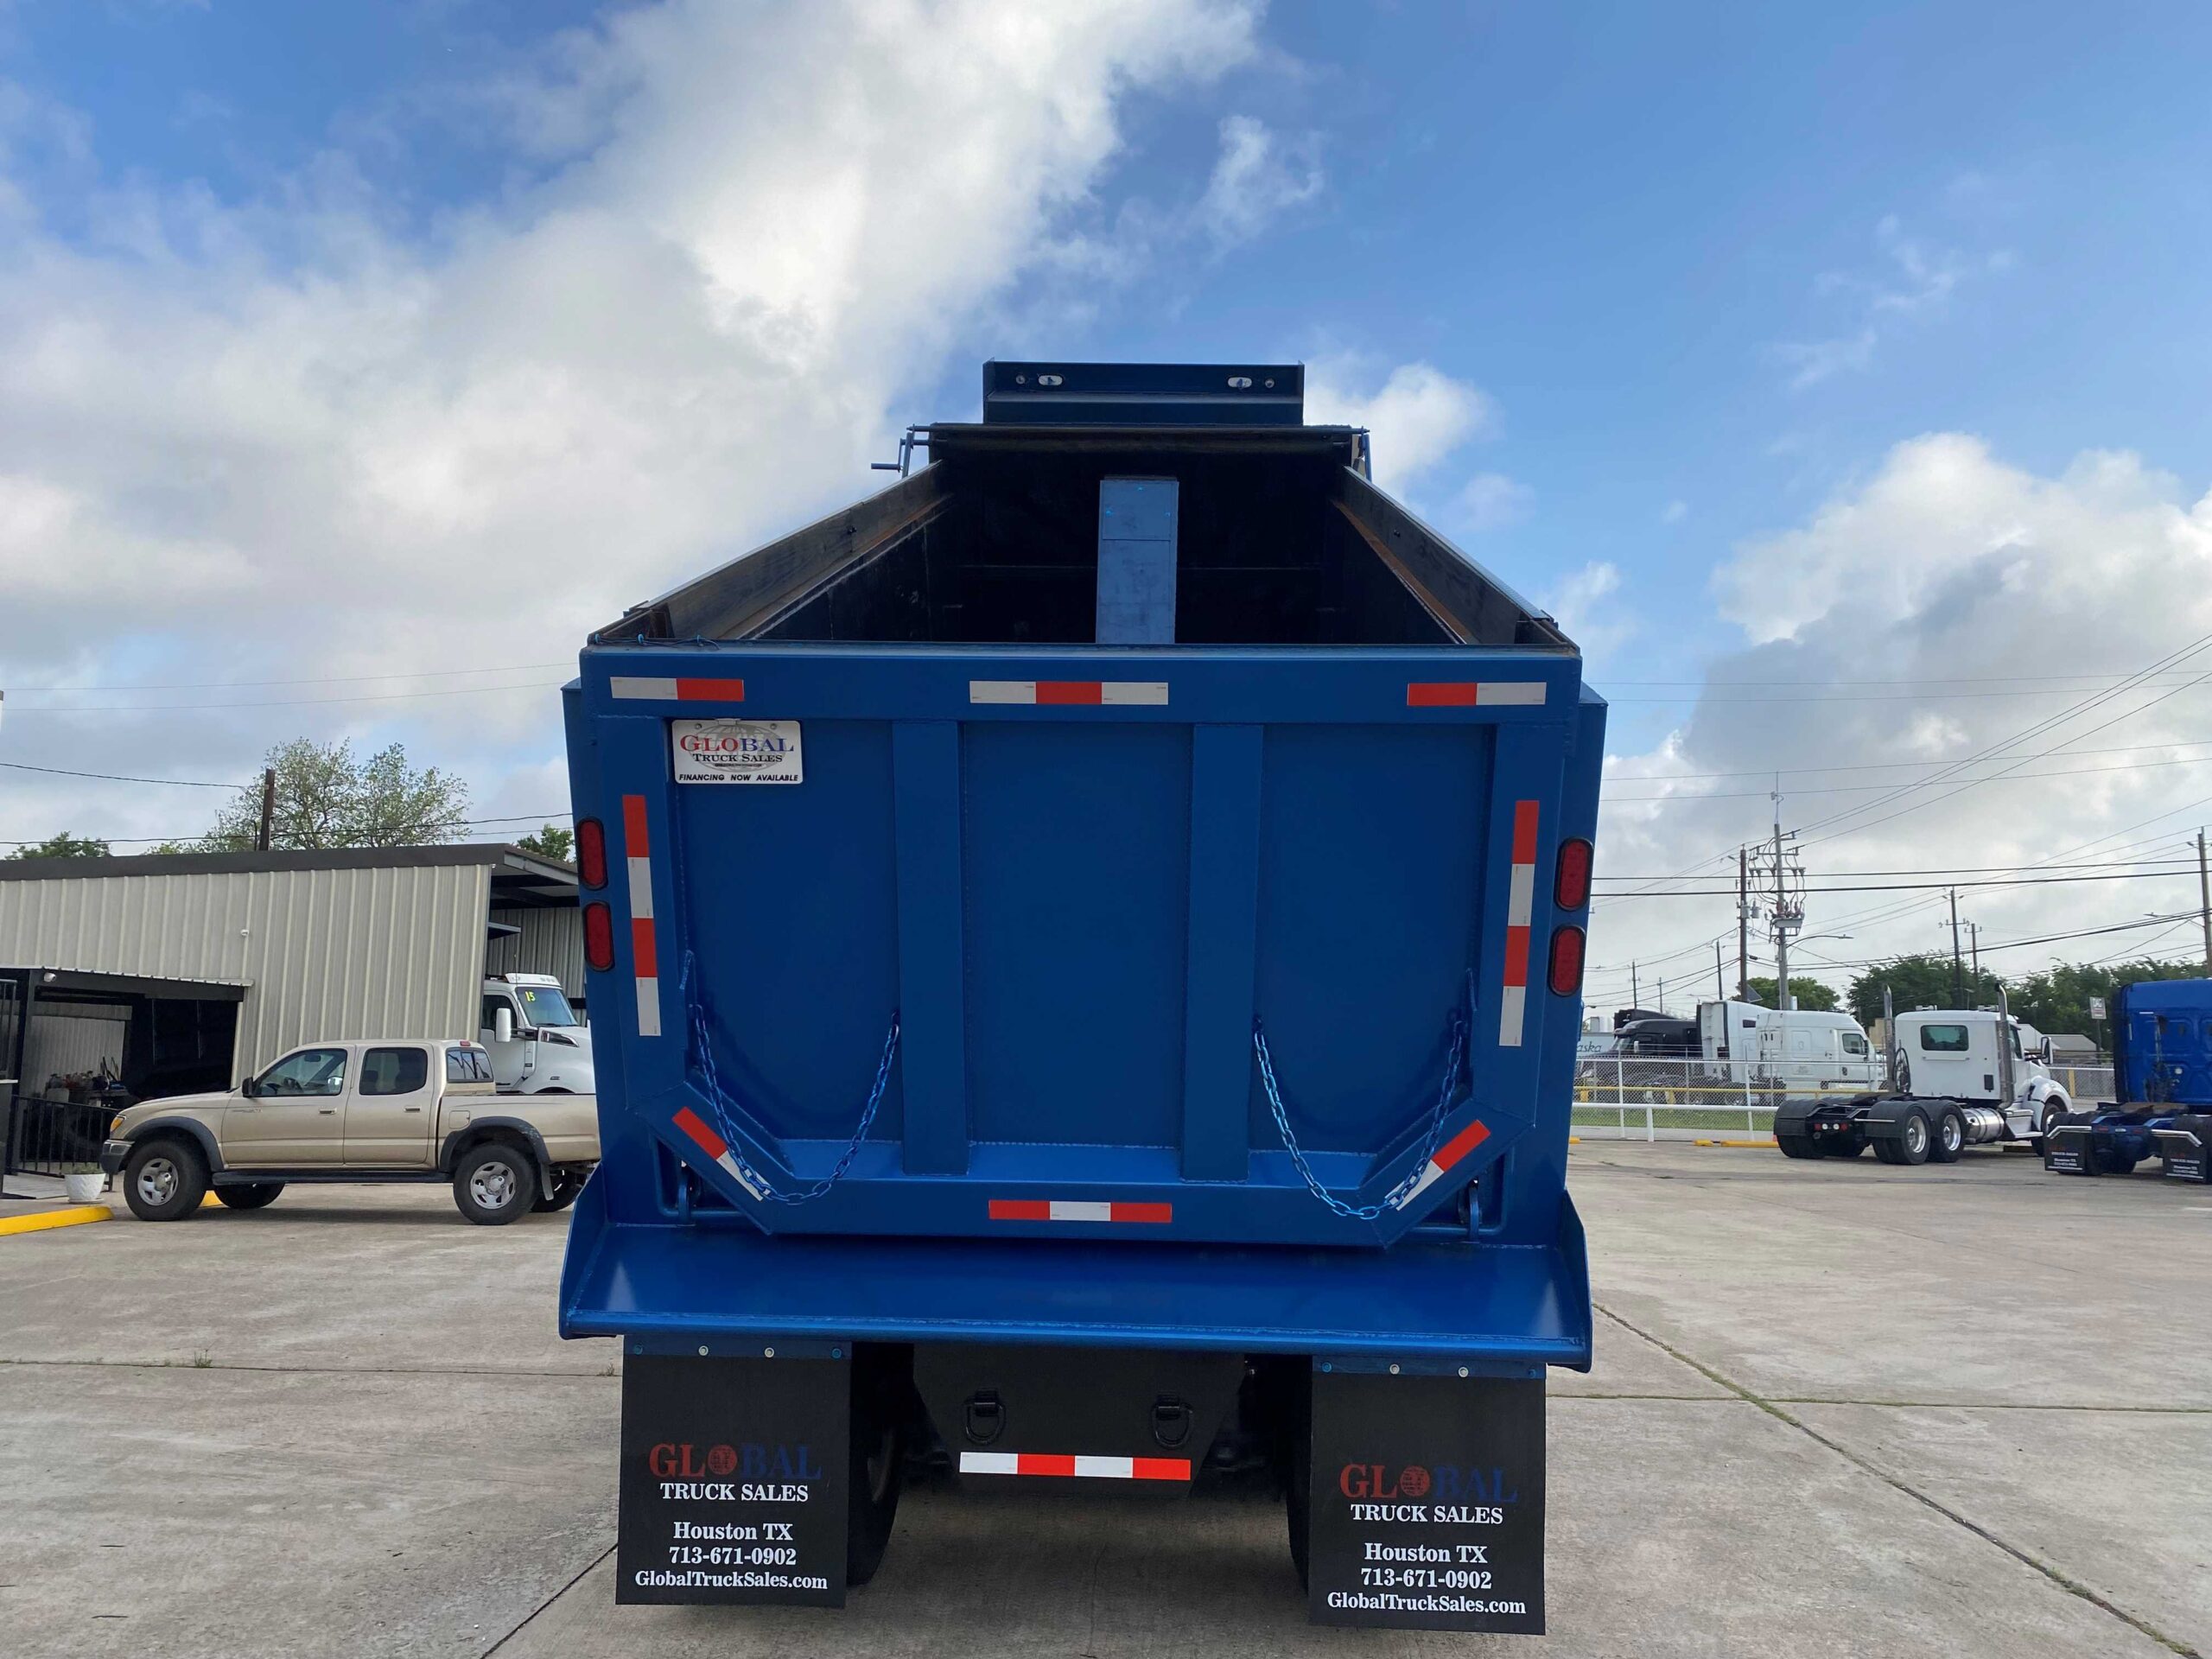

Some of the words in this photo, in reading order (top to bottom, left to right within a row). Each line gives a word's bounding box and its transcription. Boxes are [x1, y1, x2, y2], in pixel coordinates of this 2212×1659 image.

[680, 734, 794, 752] GLOBAL
[692, 753, 737, 762] TRUCK
[742, 753, 783, 762] SALES
[649, 1443, 822, 1480] GLOBAL
[659, 1483, 735, 1501] TRUCK
[741, 1484, 809, 1503] SALES
[1339, 1463, 1518, 1503] GLOBAL
[1350, 1503, 1428, 1522] TRUCK
[1433, 1506, 1503, 1525] SALES
[672, 1522, 758, 1540] Houston
[762, 1522, 793, 1541] TX
[669, 1546, 797, 1566] 713-671-0902
[1363, 1542, 1451, 1563] Houston
[1456, 1545, 1488, 1564] TX
[635, 1570, 828, 1590] GlobalTruckSales.com
[1360, 1567, 1492, 1589] 713-671-0902
[1327, 1592, 1527, 1614] GlobalTruckSales.com
